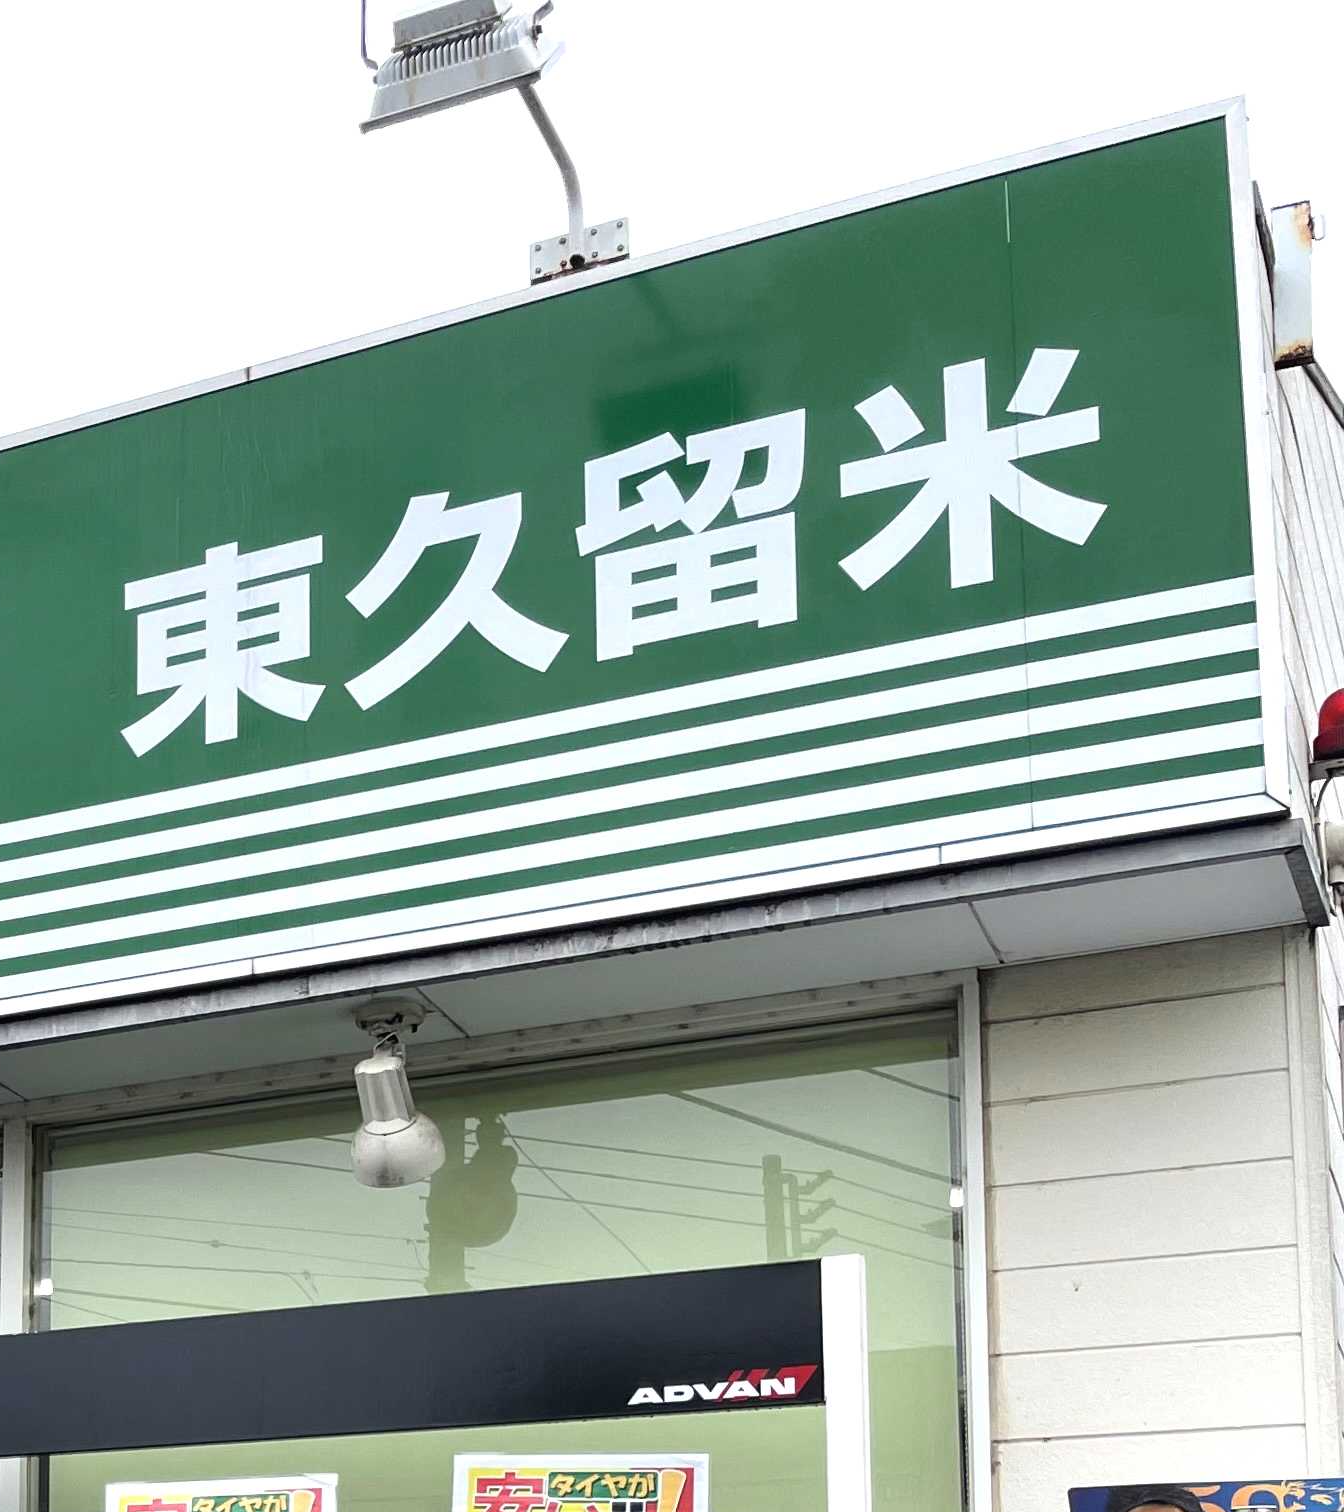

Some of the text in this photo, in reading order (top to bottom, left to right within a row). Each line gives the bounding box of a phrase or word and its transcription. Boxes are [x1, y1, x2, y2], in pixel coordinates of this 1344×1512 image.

[121, 348, 1108, 759] 東久留米
[628, 1377, 796, 1405] ADVAN
[549, 1472, 657, 1498] タイヤが
